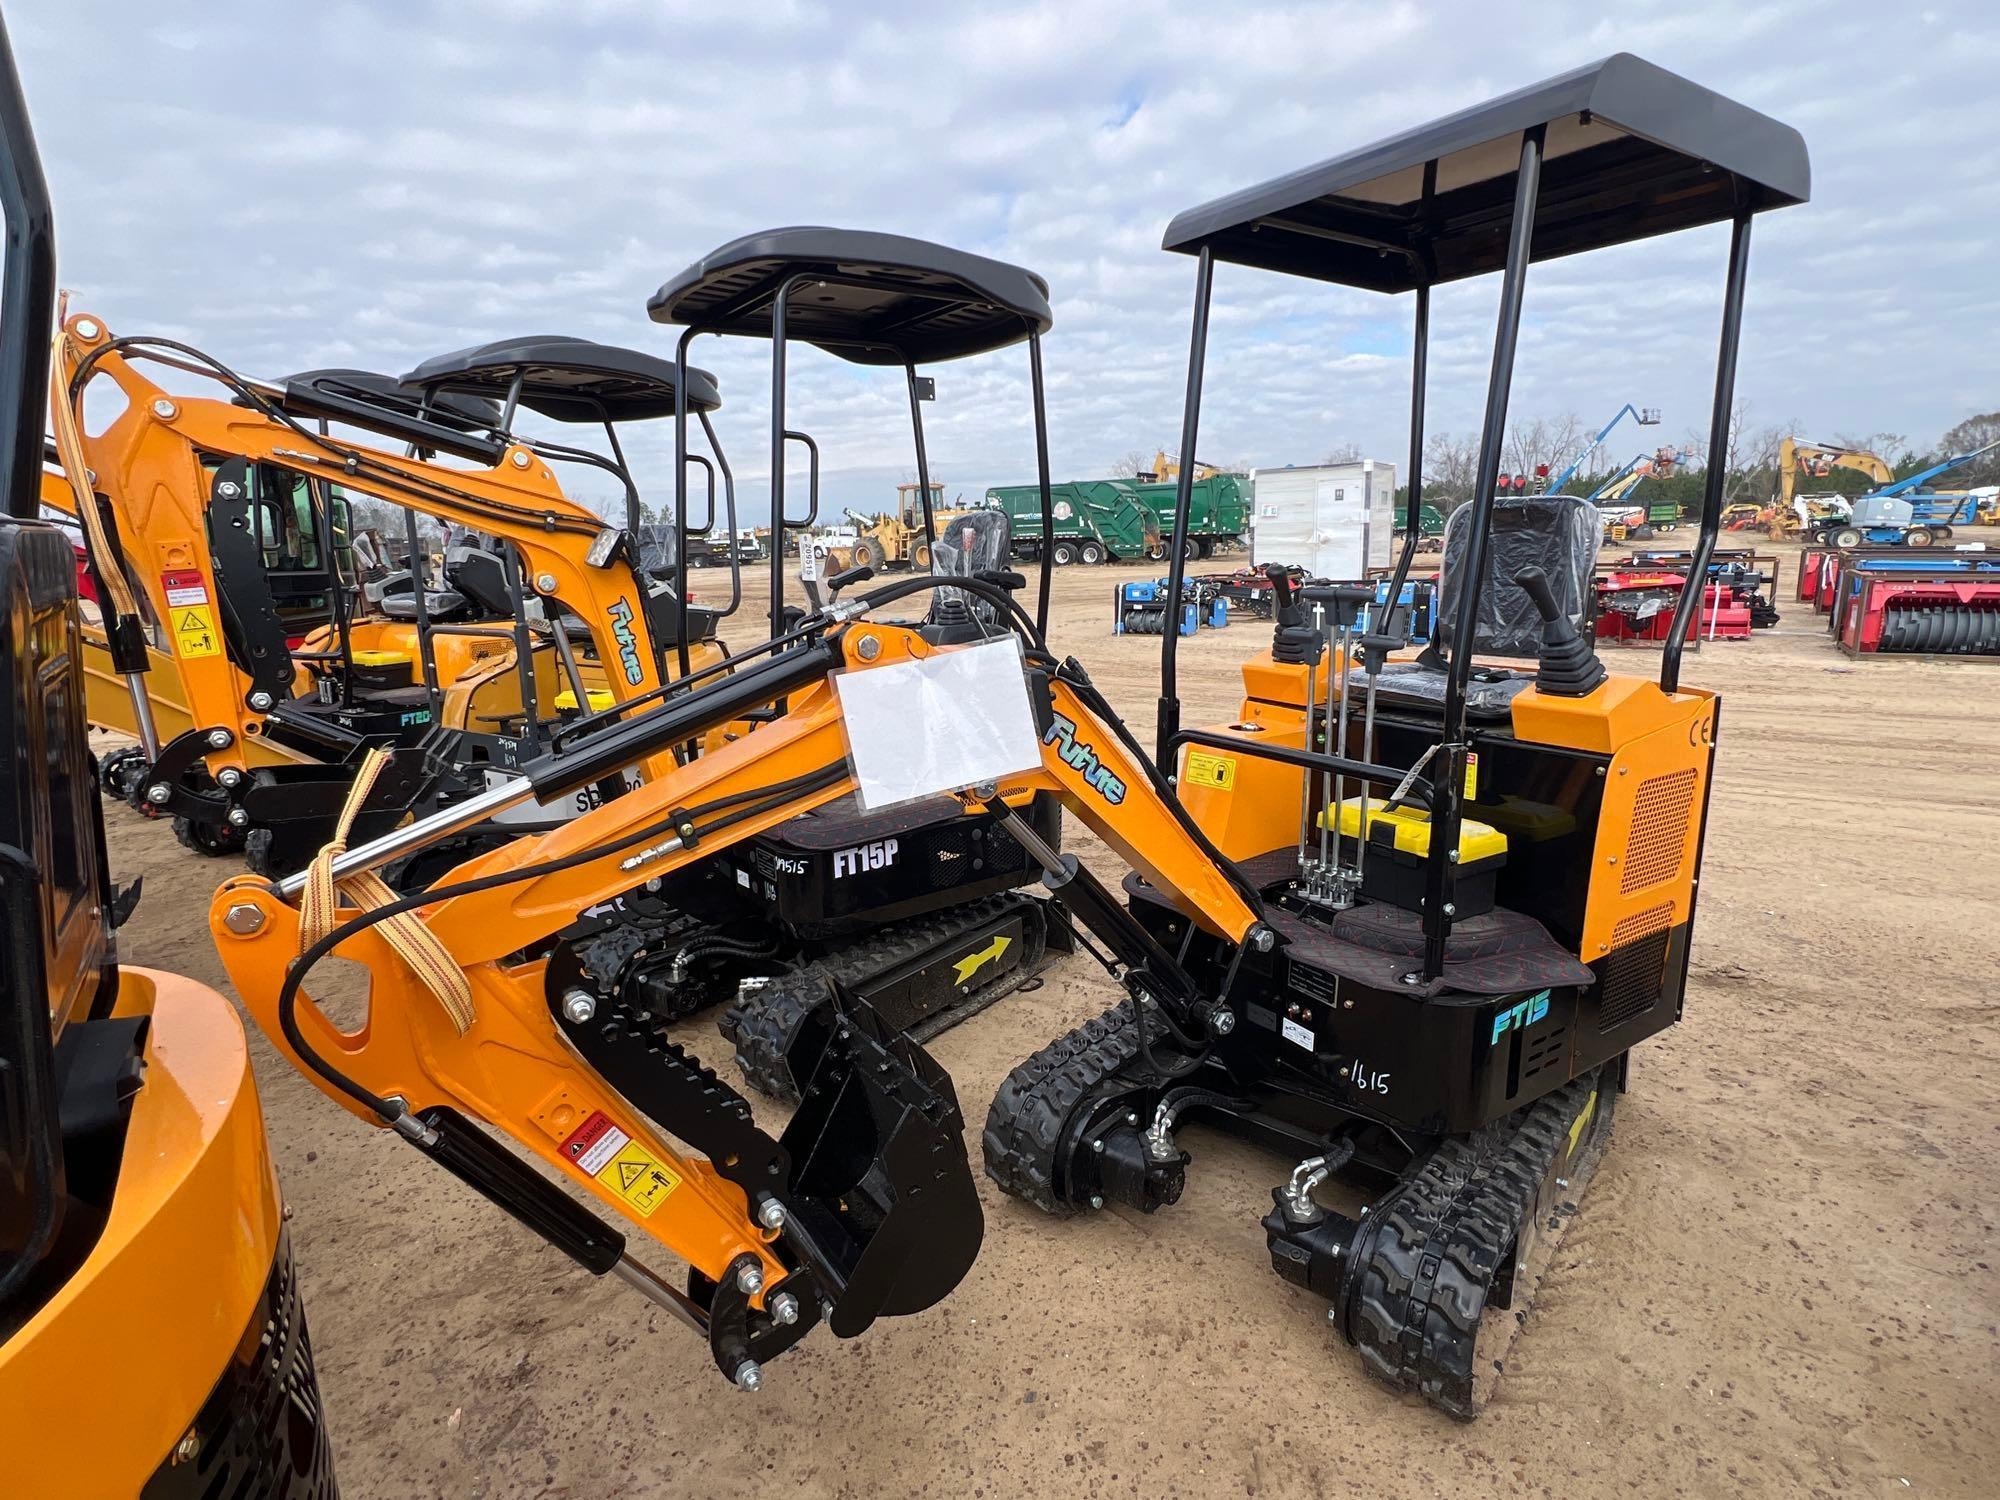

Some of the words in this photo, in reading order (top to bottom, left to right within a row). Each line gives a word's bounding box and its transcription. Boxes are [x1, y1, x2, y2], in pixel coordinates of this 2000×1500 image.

[804, 543, 814, 575] 209515
[607, 595, 644, 686] Future
[401, 710, 432, 727] FT20
[1689, 716, 1710, 747] CE
[1043, 711, 1127, 805] Future
[834, 838, 898, 879] FT15P
[1491, 988, 1551, 1046] FT15
[1351, 1059, 1390, 1094] 1615
[582, 1118, 607, 1143] DANGER
